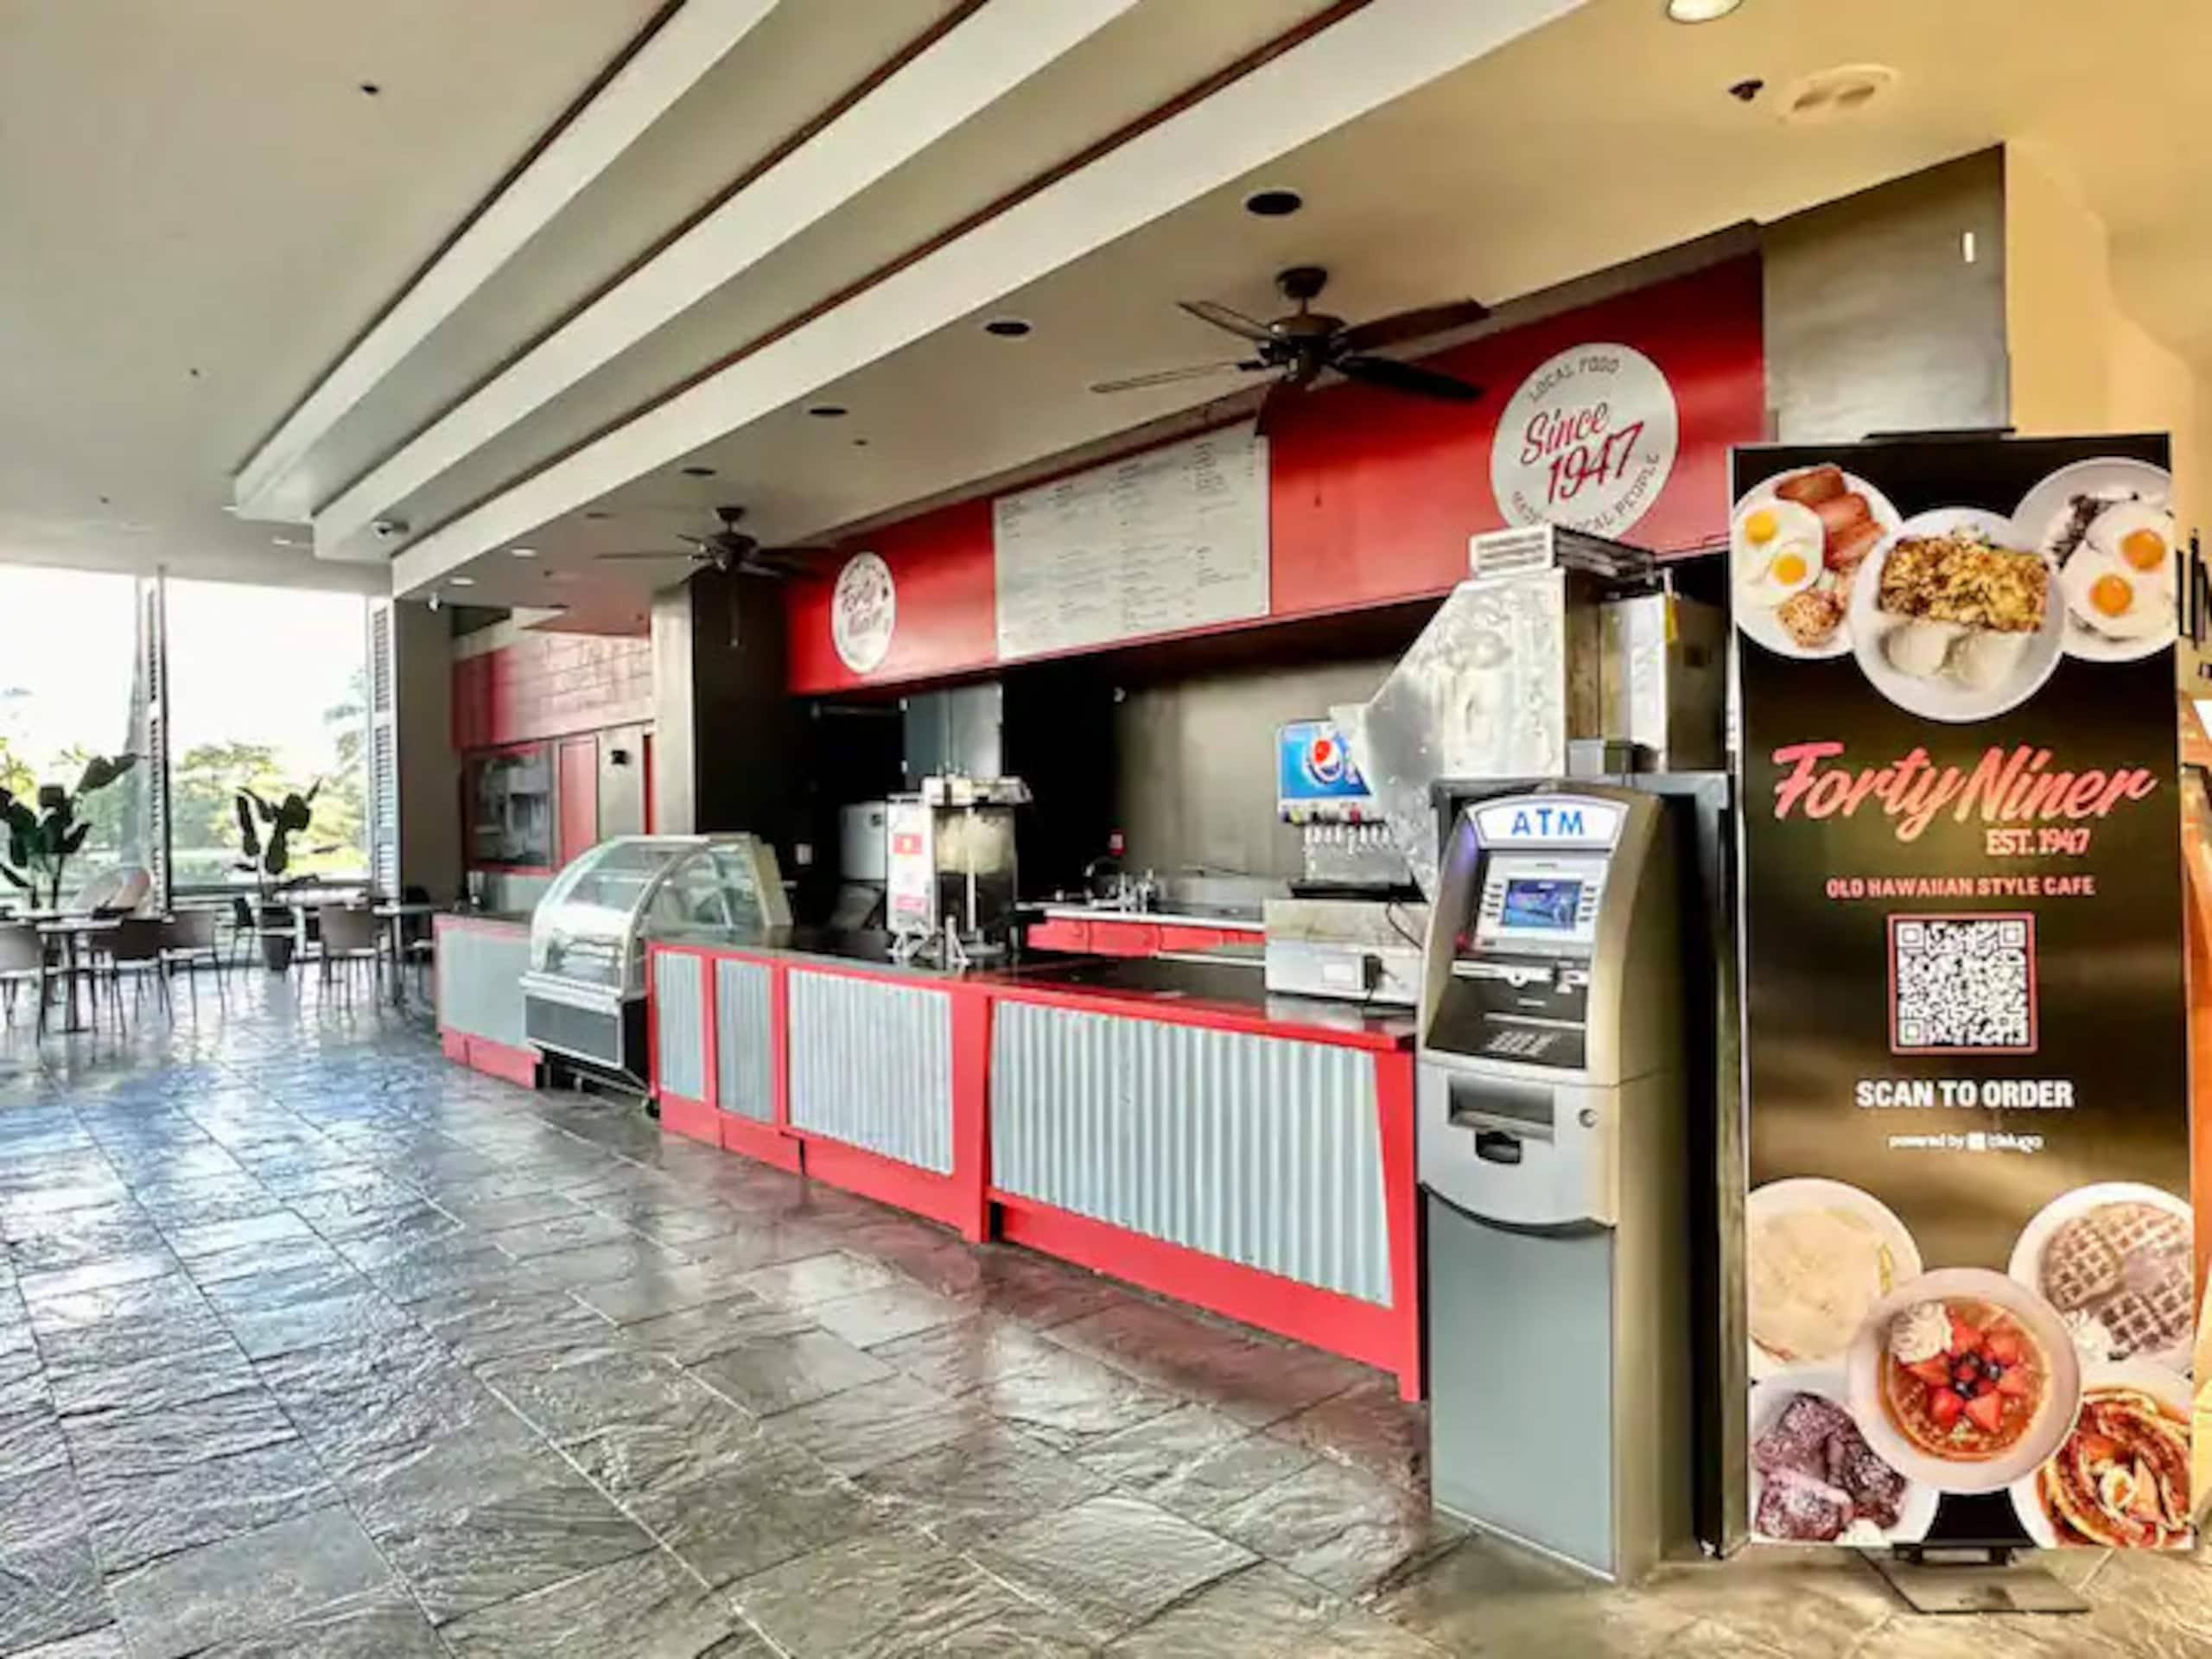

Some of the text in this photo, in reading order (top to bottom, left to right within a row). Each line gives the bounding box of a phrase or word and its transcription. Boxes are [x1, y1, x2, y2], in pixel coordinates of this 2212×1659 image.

[1529, 356, 1620, 403] LOCAL FOOD
[1520, 402, 1608, 465] Since
[1548, 421, 1644, 505] 1947
[1772, 741, 2158, 842] Forty Niner
[1511, 808, 1584, 836] ATM
[1986, 827, 2091, 855] EST. 1947
[1826, 875, 2096, 899] OLD HAWAIIAN STYLE CAFE
[1856, 1080, 2074, 1107] SCAN TO ORDER
